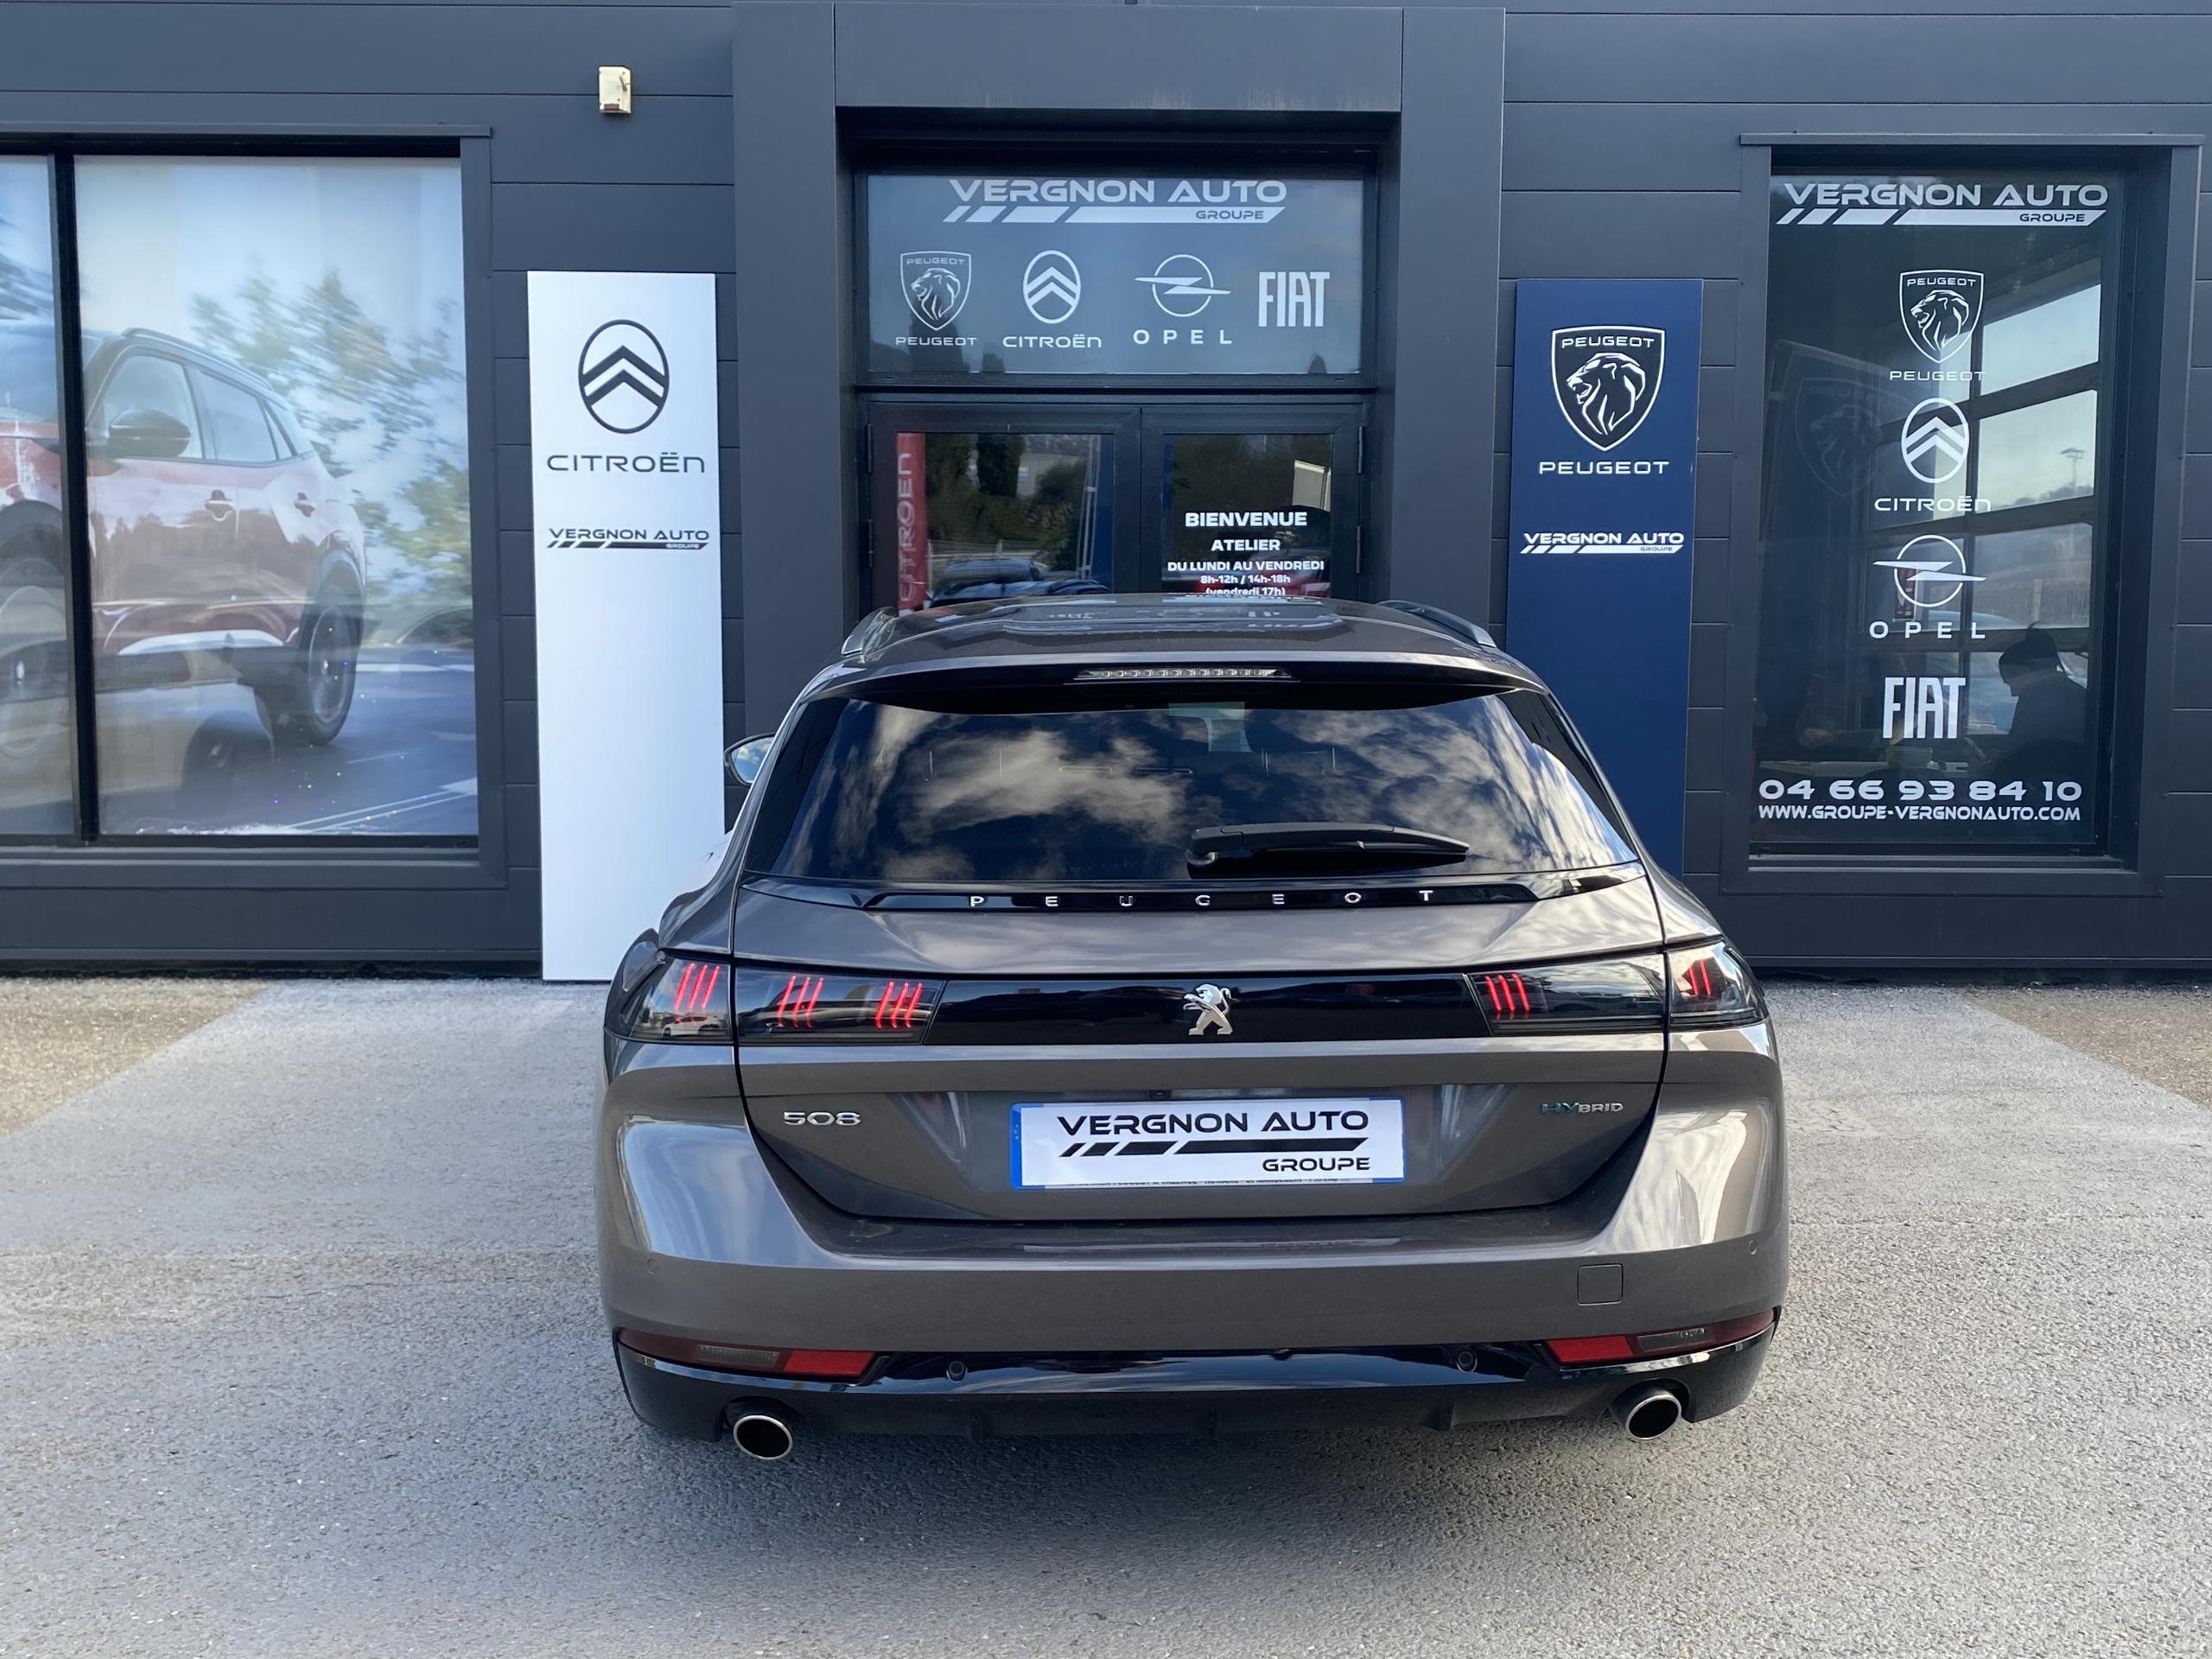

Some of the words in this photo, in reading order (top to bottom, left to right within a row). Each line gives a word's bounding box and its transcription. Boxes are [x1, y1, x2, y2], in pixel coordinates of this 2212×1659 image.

[949, 179, 1154, 203] VERGNON
[1167, 180, 1287, 203] AUTO
[1783, 182, 1980, 206] VERGNON
[1993, 184, 2109, 207] AUTO
[1195, 209, 1265, 220] GROUPE
[2019, 213, 2086, 223] GROUPE
[1906, 276, 1977, 288] PEUGEOT
[1258, 270, 1331, 328] FIAT
[895, 336, 977, 346] PEUGEOT
[1002, 334, 1103, 348] CITROËN
[1133, 329, 1232, 345] OPEL
[1561, 336, 1655, 348] PEUGEOT
[1890, 370, 1986, 382] PEUGEOT
[546, 452, 705, 474] CITROËN
[1539, 461, 1669, 475] PEUGEOT
[1873, 495, 1992, 512] CITROËN
[1185, 512, 1307, 527] BIENVENUE
[549, 528, 647, 541] VERGNON
[652, 530, 709, 541] AUTO
[1523, 532, 1622, 544] VERGNON
[1626, 533, 1684, 544] AUTO
[1211, 539, 1281, 551] ATELIER
[1167, 562, 1187, 571] DU
[1190, 562, 1230, 571] LUNDI
[1233, 562, 1253, 571] AU
[1255, 561, 1325, 570] VENDREDI
[1200, 575, 1238, 584] 8h-12h
[1240, 575, 1245, 585] /
[1248, 575, 1291, 583] 14h-18h
[1262, 587, 1286, 596] 17h)
[1869, 621, 1986, 639] OPEL
[1882, 677, 1966, 739] FIAT
[1758, 779, 1815, 799] 04
[1828, 779, 1885, 800] 66
[1897, 780, 1955, 800] 93
[1968, 781, 2027, 801] 84
[2041, 781, 2082, 801] 10
[1758, 804, 2081, 821] WWW.GROUPE-VERGNONAUTO.COM
[969, 889, 1434, 906] PEUGEOT
[1541, 1102, 1624, 1114] HYBRID
[783, 1111, 861, 1126] 508
[1057, 1112, 1247, 1136] VERGNON
[1261, 1109, 1369, 1132] AUTO
[1262, 1157, 1370, 1172] GROUPE
